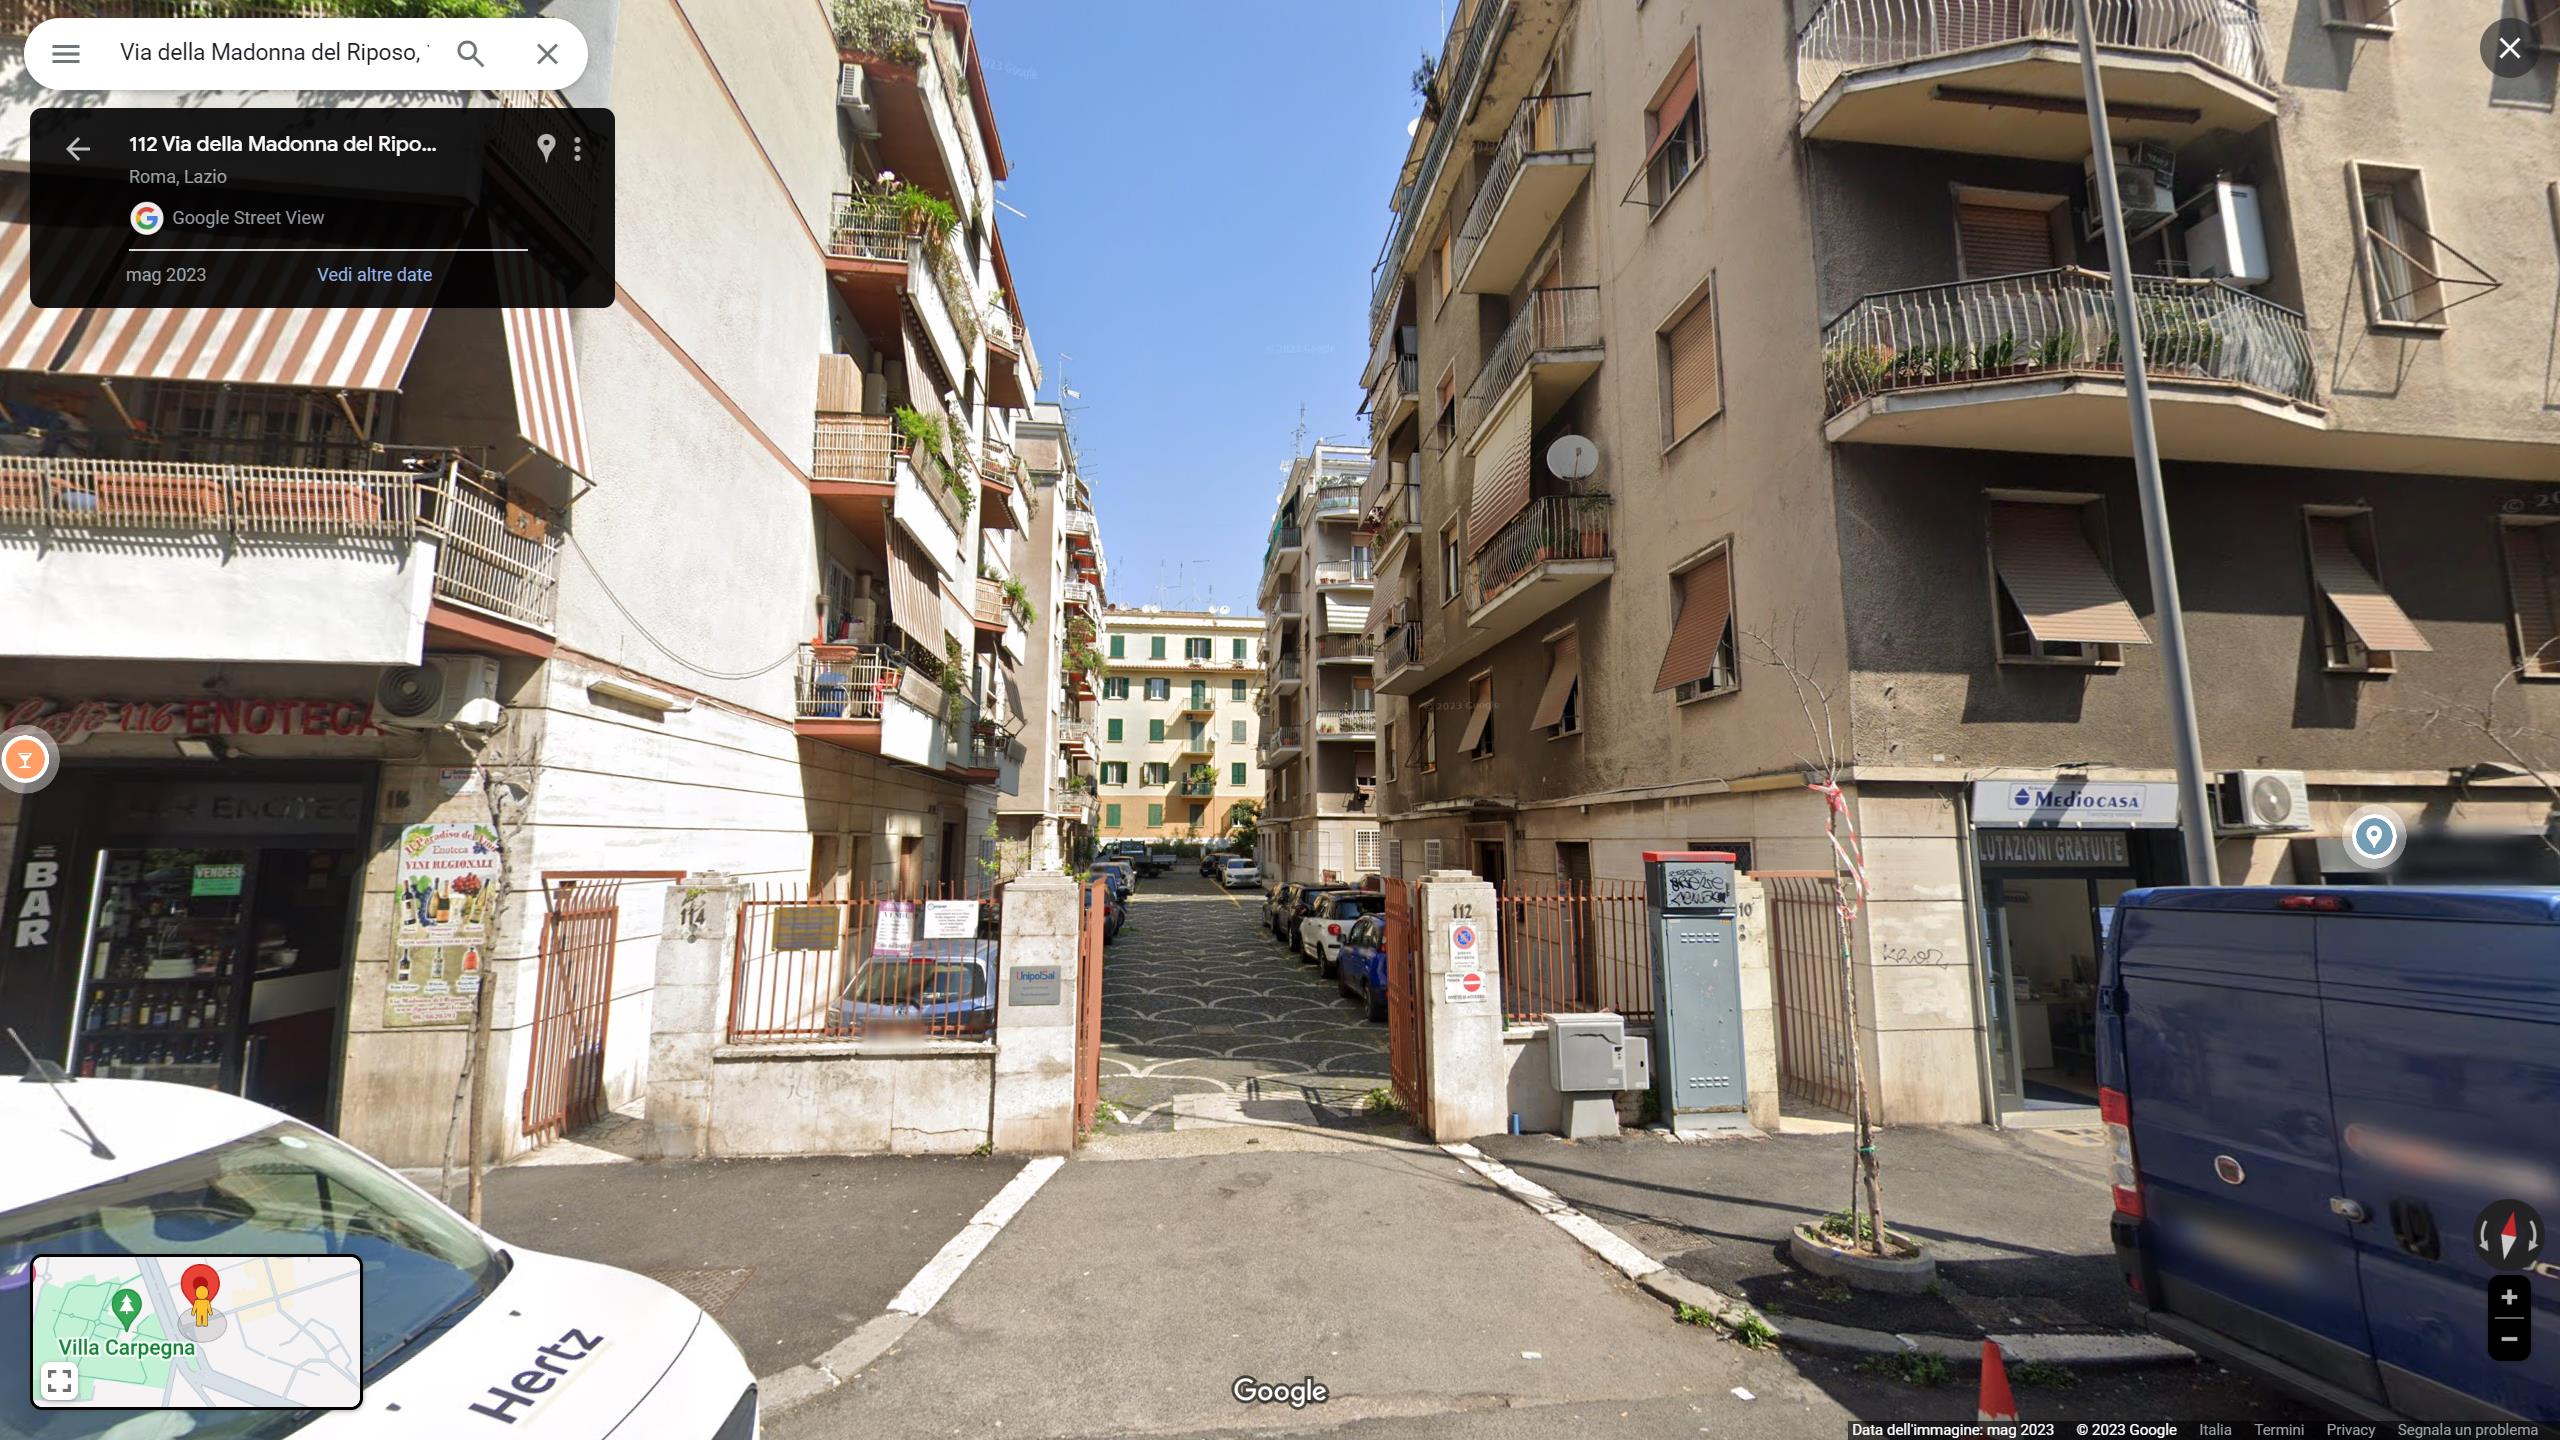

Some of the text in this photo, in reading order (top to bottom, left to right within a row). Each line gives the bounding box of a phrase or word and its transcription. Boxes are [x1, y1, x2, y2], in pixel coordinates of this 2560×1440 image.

[119, 702, 175, 734] 116
[184, 699, 386, 737] ENOTECA
[415, 829, 460, 849] Paradiso
[2055, 835, 2123, 861] GRATUITE
[432, 845, 469, 855] Enoteca
[405, 858, 494, 870] VINI REGIONALI
[14, 861, 60, 948] BAR
[1452, 903, 1473, 919] 112
[680, 907, 706, 926] 114
[1015, 969, 1056, 984] UnipolSai
[468, 1327, 606, 1426] Hertz
